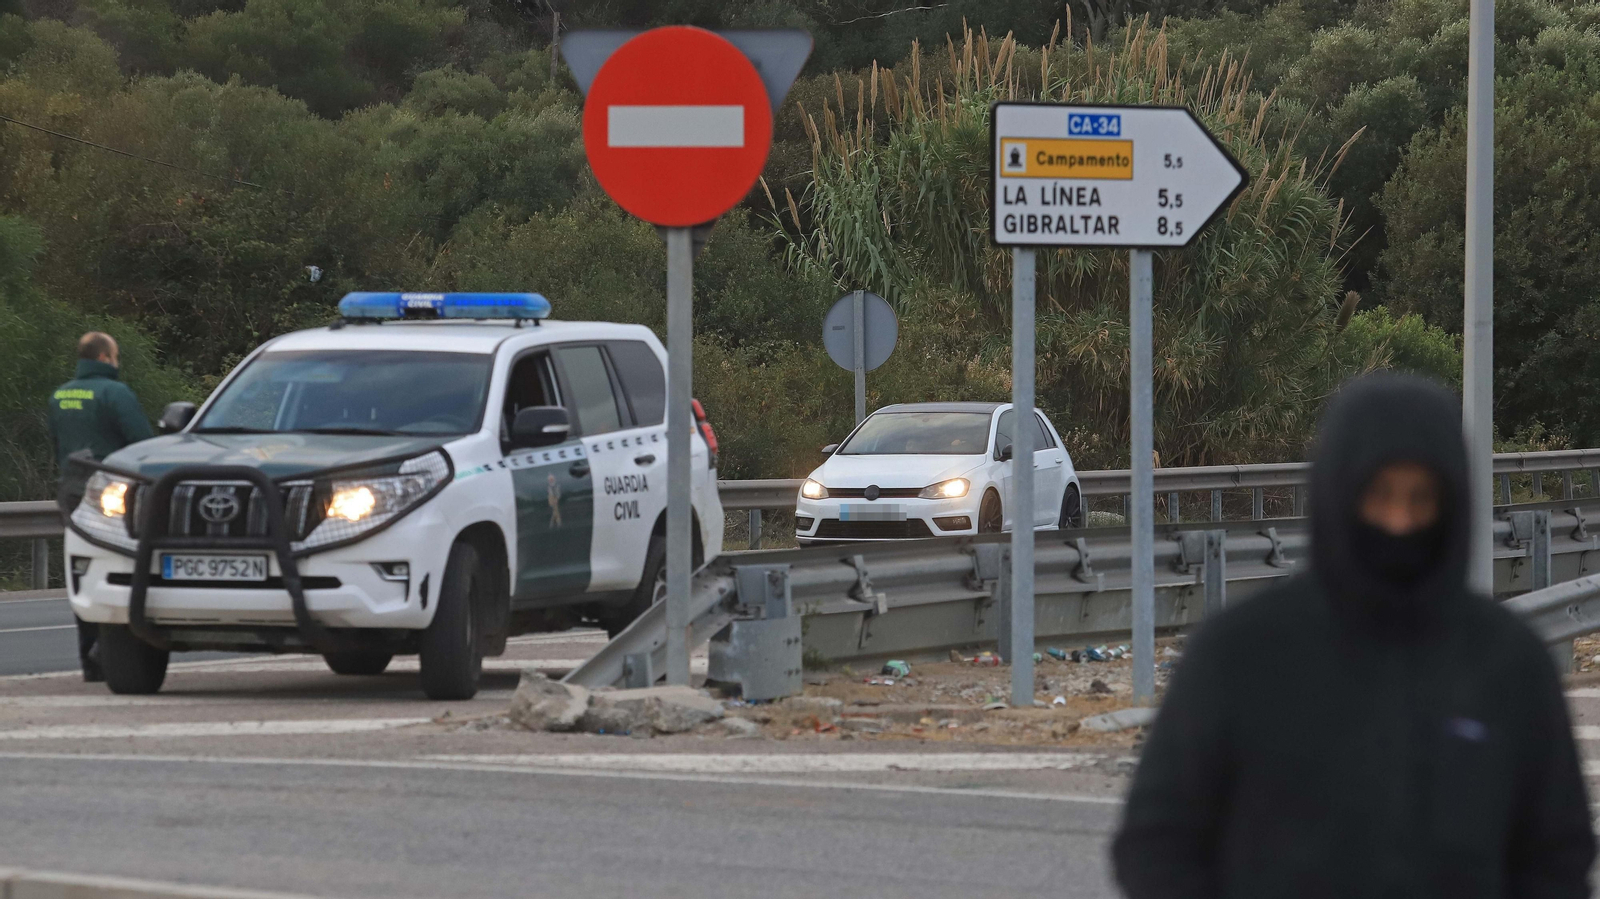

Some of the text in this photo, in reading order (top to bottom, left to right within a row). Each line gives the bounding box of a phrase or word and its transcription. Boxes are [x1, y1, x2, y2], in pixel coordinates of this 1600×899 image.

[1069, 116, 1120, 134] CA-34
[1036, 150, 1184, 169] Campamento 5,5
[1003, 181, 1184, 210] LA LÍNEA 5,5
[1003, 214, 1184, 237] GIBRALTAR 8,5
[54, 389, 94, 400] GUARDIA
[60, 400, 83, 410] CIVIL
[604, 475, 648, 495] GUARDIA
[614, 501, 640, 521] CIVIL
[174, 559, 206, 576] PGC
